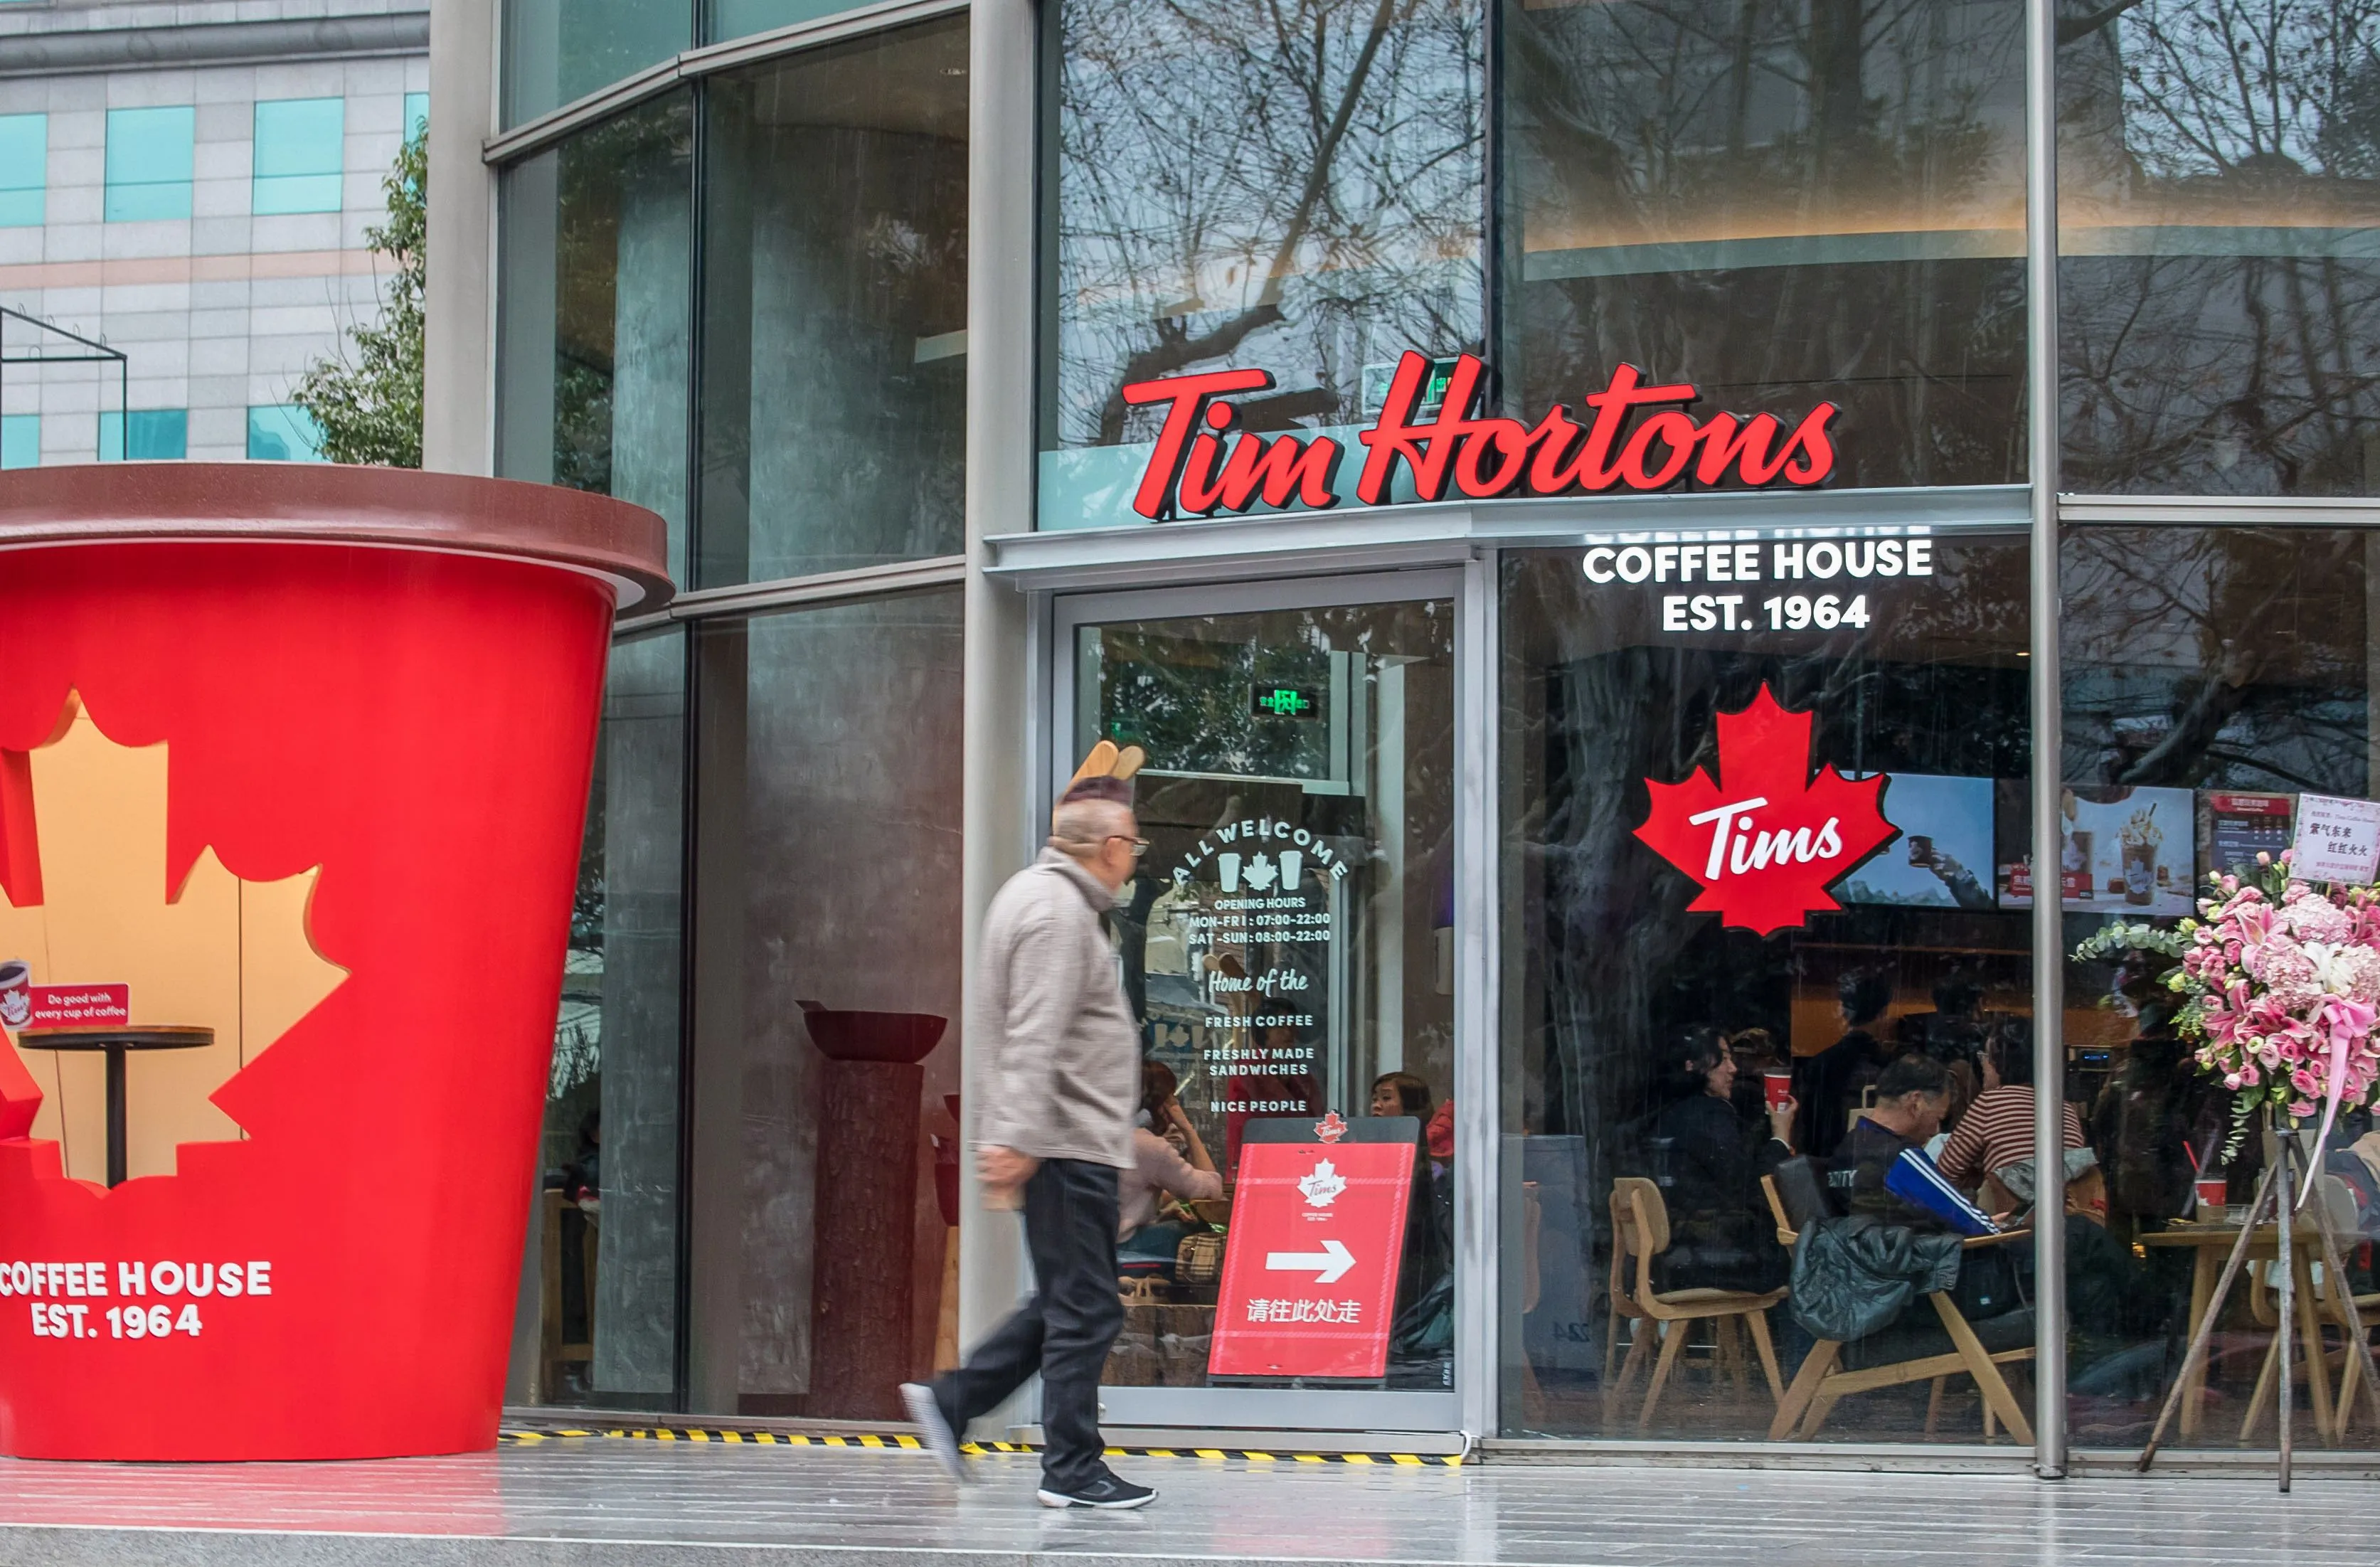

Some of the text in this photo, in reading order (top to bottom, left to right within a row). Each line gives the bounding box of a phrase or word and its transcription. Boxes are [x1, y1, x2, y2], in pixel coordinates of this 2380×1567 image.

[1122, 349, 1839, 520] Tim Hortons
[1582, 540, 1933, 584] COFFEE HOUSE
[1662, 594, 1870, 632] EST. 1964
[1689, 796, 1842, 881] Tims
[2327, 841, 2369, 856] 红红火火
[1172, 819, 1349, 886] ALL WELCOME
[1214, 896, 1307, 910] OPENING HOURS
[1208, 968, 1309, 997] Home of the
[48, 992, 112, 1006] Do good with
[35, 1005, 126, 1021] every cup of coffee
[1205, 1015, 1313, 1028] FRESH COFFEE
[1204, 1048, 1314, 1061] FRESHLY MADE
[1209, 1063, 1308, 1075] SANDWICHES
[1211, 1100, 1307, 1112] NICE PEOPLE
[1307, 1180, 1337, 1197] Tims
[0, 1260, 272, 1297] COFFEE HOUSE
[30, 1302, 203, 1339] EST. 1964
[1247, 1298, 1361, 1324] 请往此处走
